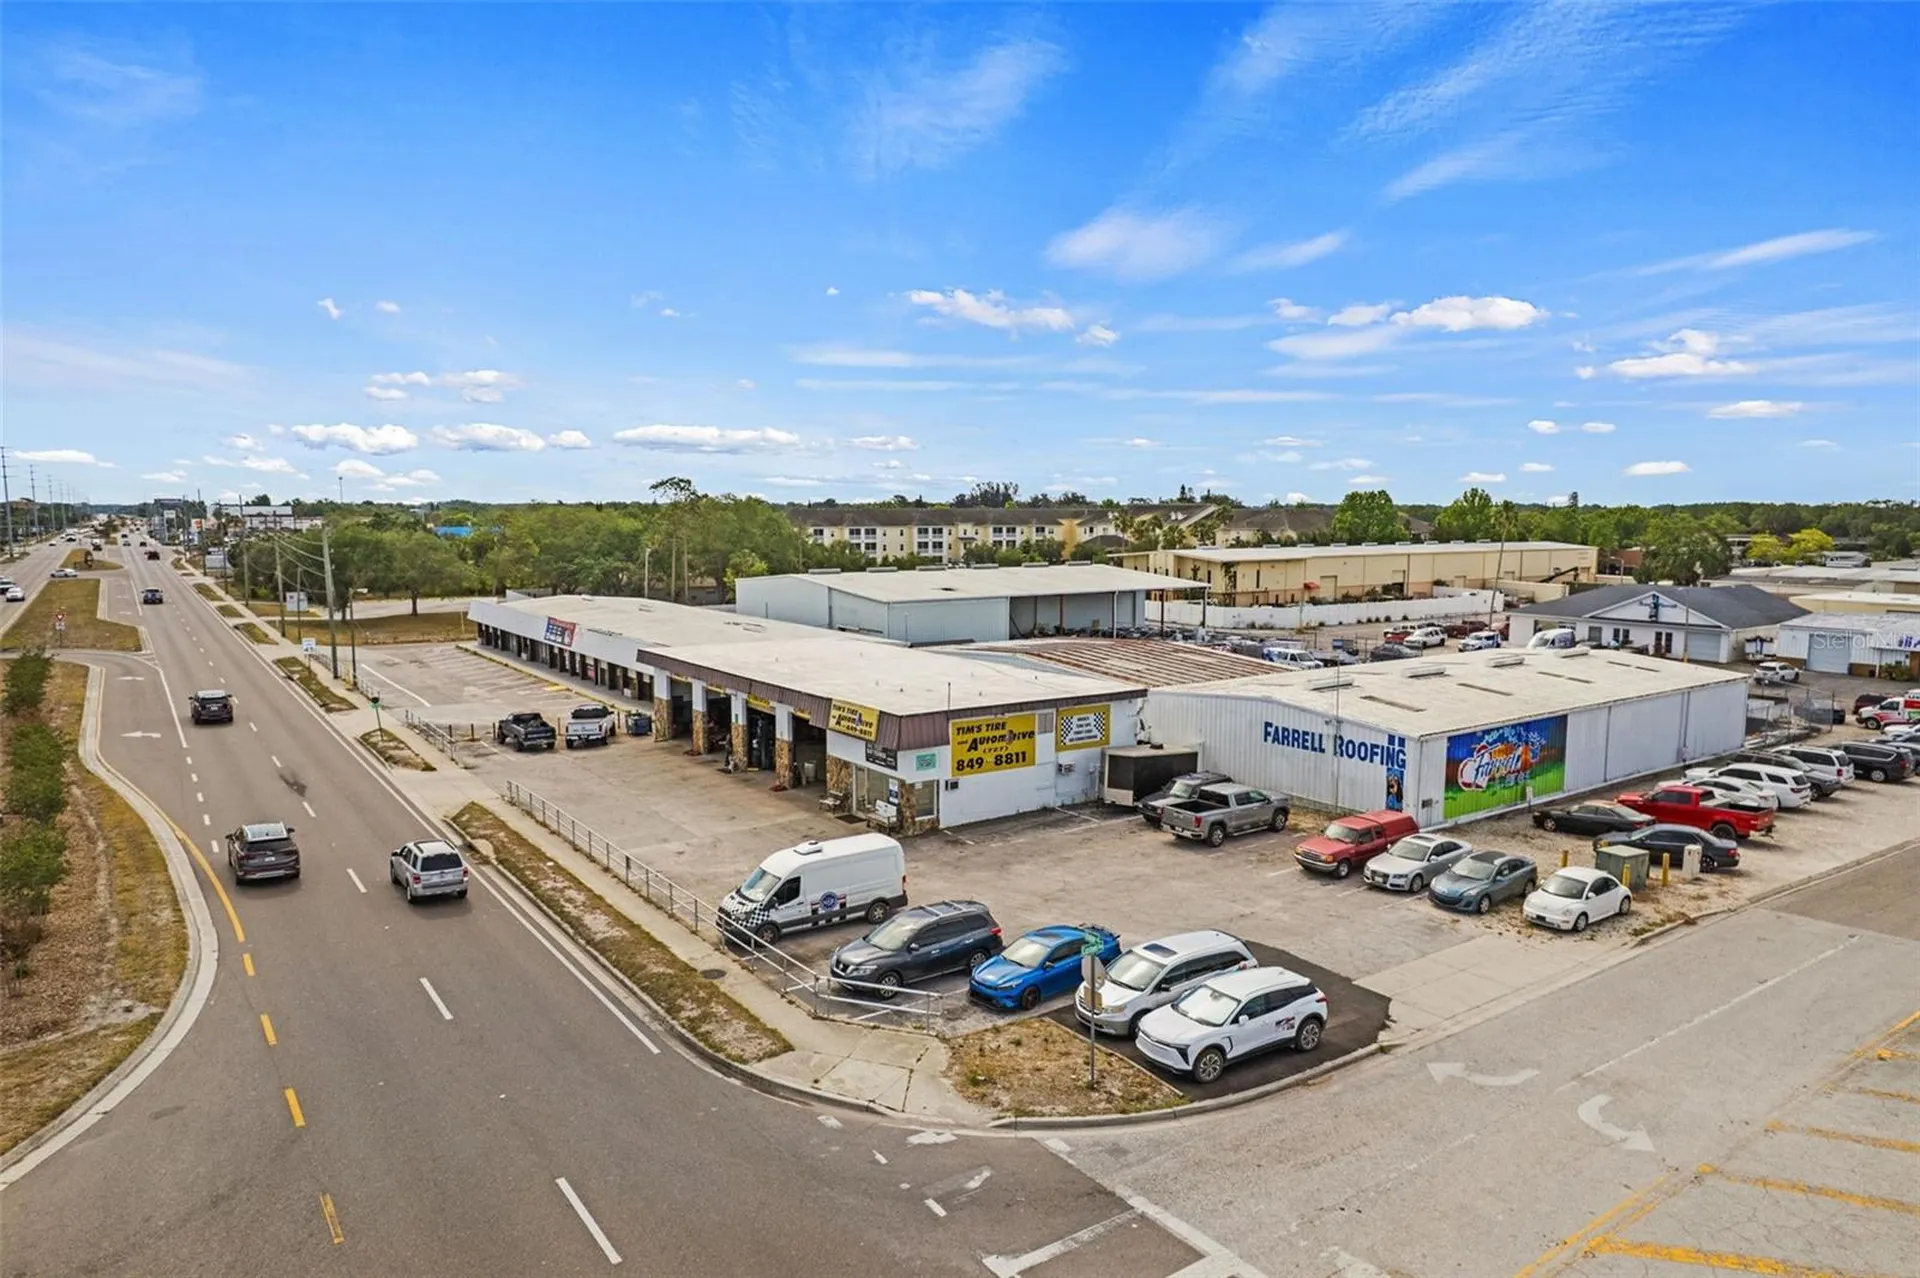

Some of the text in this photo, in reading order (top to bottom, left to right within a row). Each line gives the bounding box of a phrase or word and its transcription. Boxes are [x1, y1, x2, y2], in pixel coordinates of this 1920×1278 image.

[956, 721, 1008, 736] TIM'S TIRE
[1263, 721, 1406, 769] FARRELL ROOFING
[956, 751, 1027, 772] 849 8811
